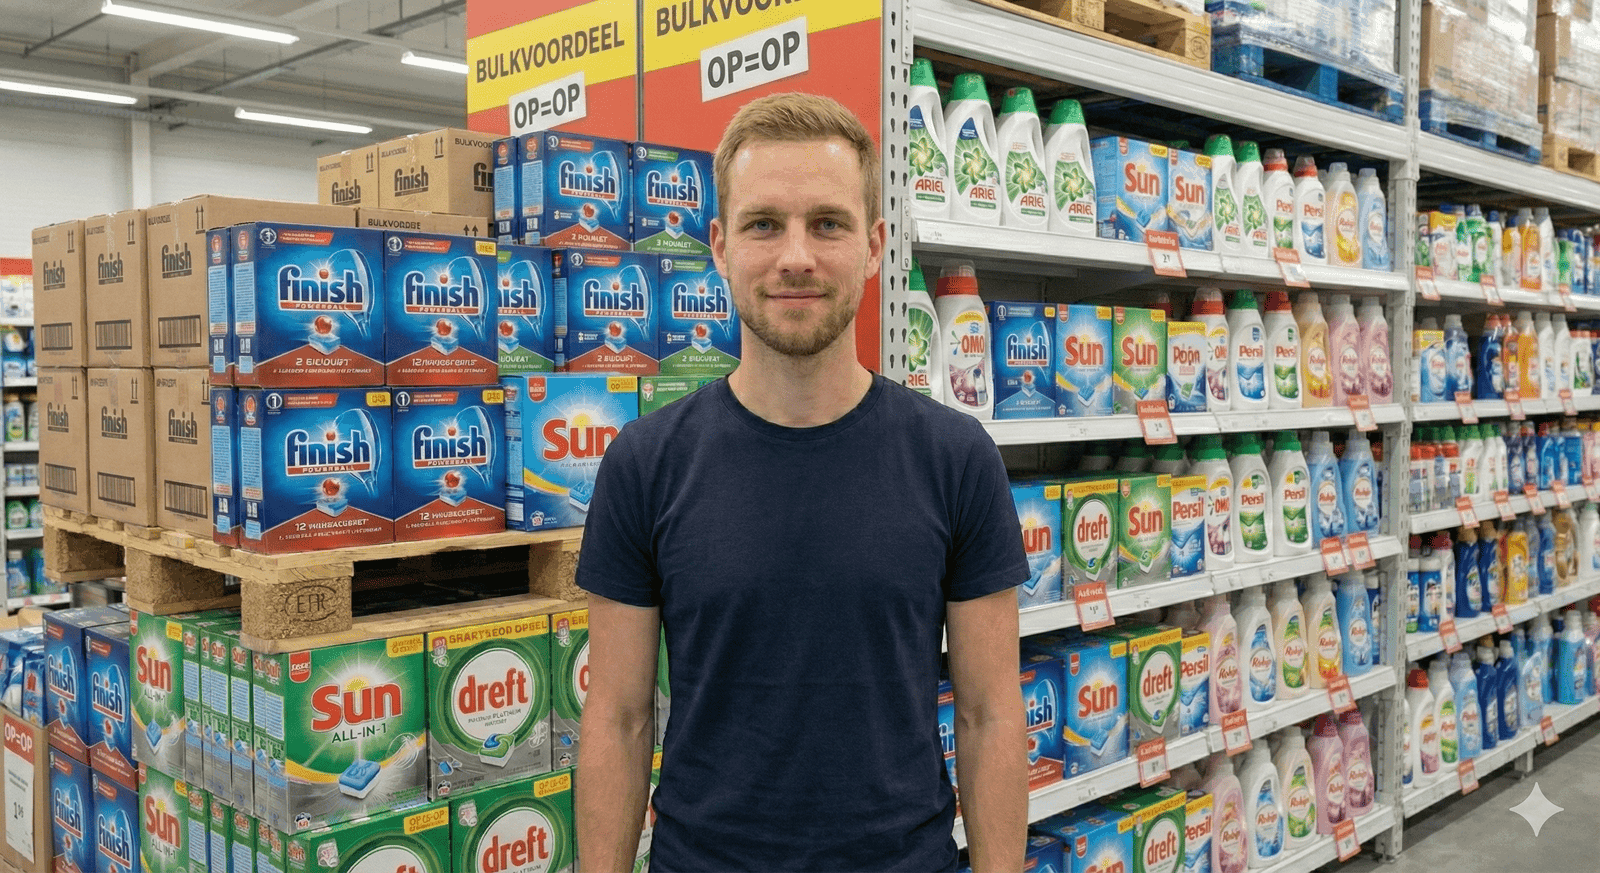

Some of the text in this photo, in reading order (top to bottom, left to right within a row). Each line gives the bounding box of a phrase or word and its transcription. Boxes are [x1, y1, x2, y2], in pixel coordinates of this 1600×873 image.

[476, 20, 625, 83] BULKVOORDEEL
[707, 30, 801, 89] OP=OP
[514, 82, 580, 129] OP=OP
[331, 178, 362, 204] finish
[394, 165, 429, 192] finish
[560, 160, 616, 194] finish
[647, 170, 698, 203] finish
[915, 178, 945, 194] ARIEL
[1125, 163, 1160, 197] Sun
[1175, 175, 1205, 206] Sun
[969, 186, 997, 201] ARIEL
[1020, 195, 1046, 209] ARIEL
[1068, 203, 1094, 216] ARIEL
[42, 259, 66, 285] finish
[97, 251, 124, 280] finish
[161, 242, 193, 273] finish
[279, 265, 363, 304] finish
[405, 272, 479, 307] finish
[584, 280, 644, 312] finish
[673, 283, 728, 314] finish
[961, 335, 985, 354] OMO
[1007, 333, 1048, 361] finish
[1065, 335, 1104, 366] Sun
[1122, 336, 1159, 366] Sun
[46, 401, 69, 427] finish
[101, 405, 128, 434] finish
[167, 408, 198, 439] finish
[286, 430, 371, 466] finish
[413, 425, 487, 461] finish
[543, 418, 619, 462] Sun
[1128, 506, 1163, 537] Sun
[1172, 496, 1205, 521] Persil
[1022, 525, 1051, 554] un
[1077, 513, 1109, 543] dreft
[48, 653, 75, 696] finish
[136, 645, 173, 694] Sun
[1142, 665, 1173, 697] dreft
[1181, 653, 1209, 678] Persil
[92, 671, 123, 716] finish
[458, 667, 529, 715] dreft
[1078, 684, 1118, 719] Sun
[311, 683, 403, 733] Sun
[4, 722, 33, 754] OP=OP
[331, 722, 387, 744] ALL-IN-1
[54, 787, 82, 834] finish
[145, 794, 181, 850] Sun
[98, 813, 130, 862] finish
[482, 825, 549, 873] dreft
[1147, 831, 1177, 866] dreft
